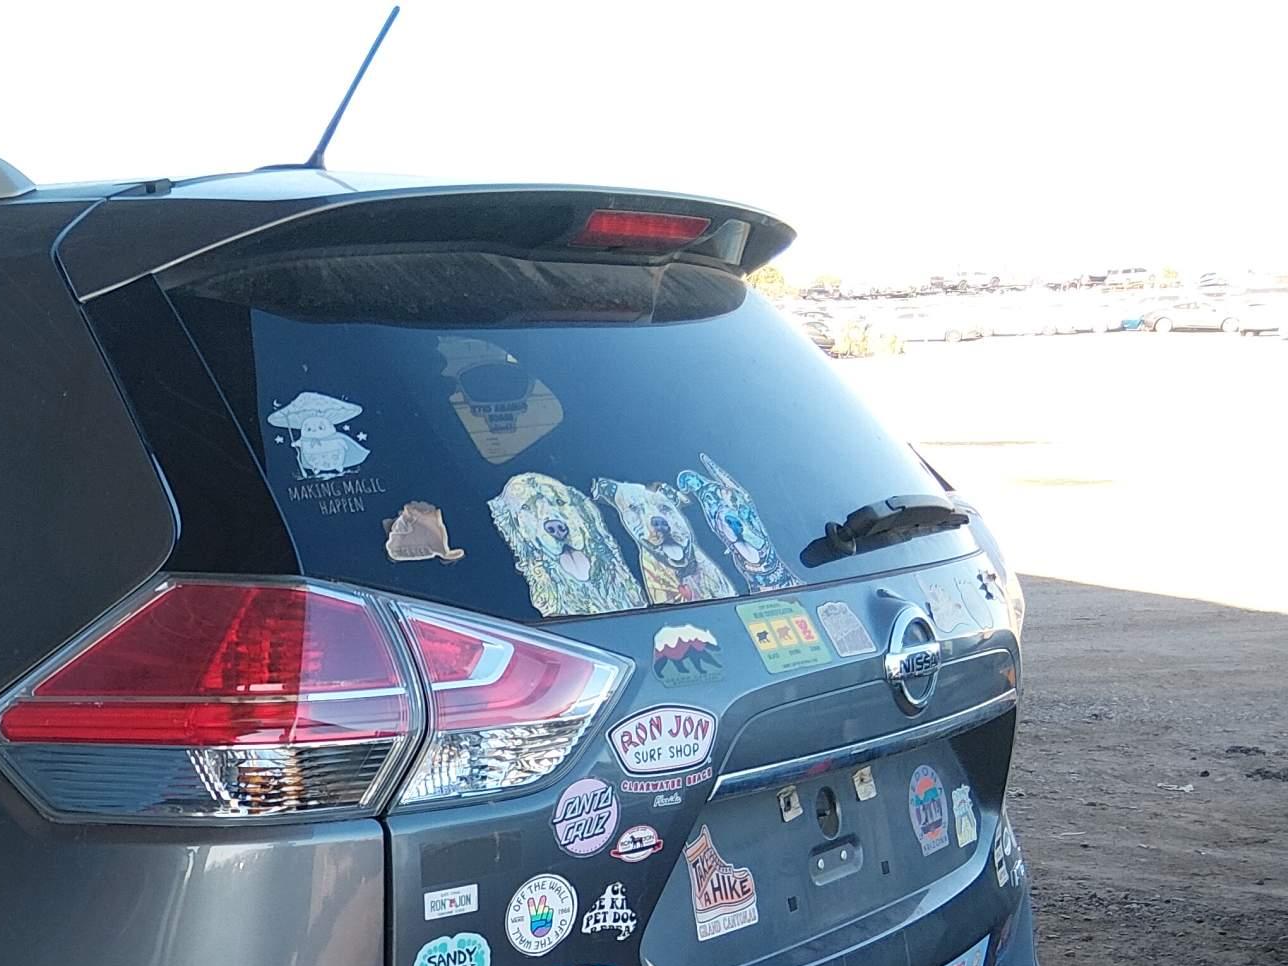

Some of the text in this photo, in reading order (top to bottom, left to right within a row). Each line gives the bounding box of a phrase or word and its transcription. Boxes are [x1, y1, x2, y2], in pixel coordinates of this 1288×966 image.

[288, 478, 386, 501] MAKING MAGIC
[319, 498, 364, 514] HAPPEN
[620, 715, 710, 755] RON JON
[634, 743, 700, 764] SURF SHOP
[621, 777, 683, 793] CLEARWATER
[552, 785, 613, 825] SANTA
[560, 810, 611, 846] CRUZ
[513, 880, 569, 912] OFF THE WALL
[710, 872, 751, 903] HIKE
[430, 898, 446, 913] RON
[456, 893, 472, 908] JON
[585, 911, 609, 929] PET
